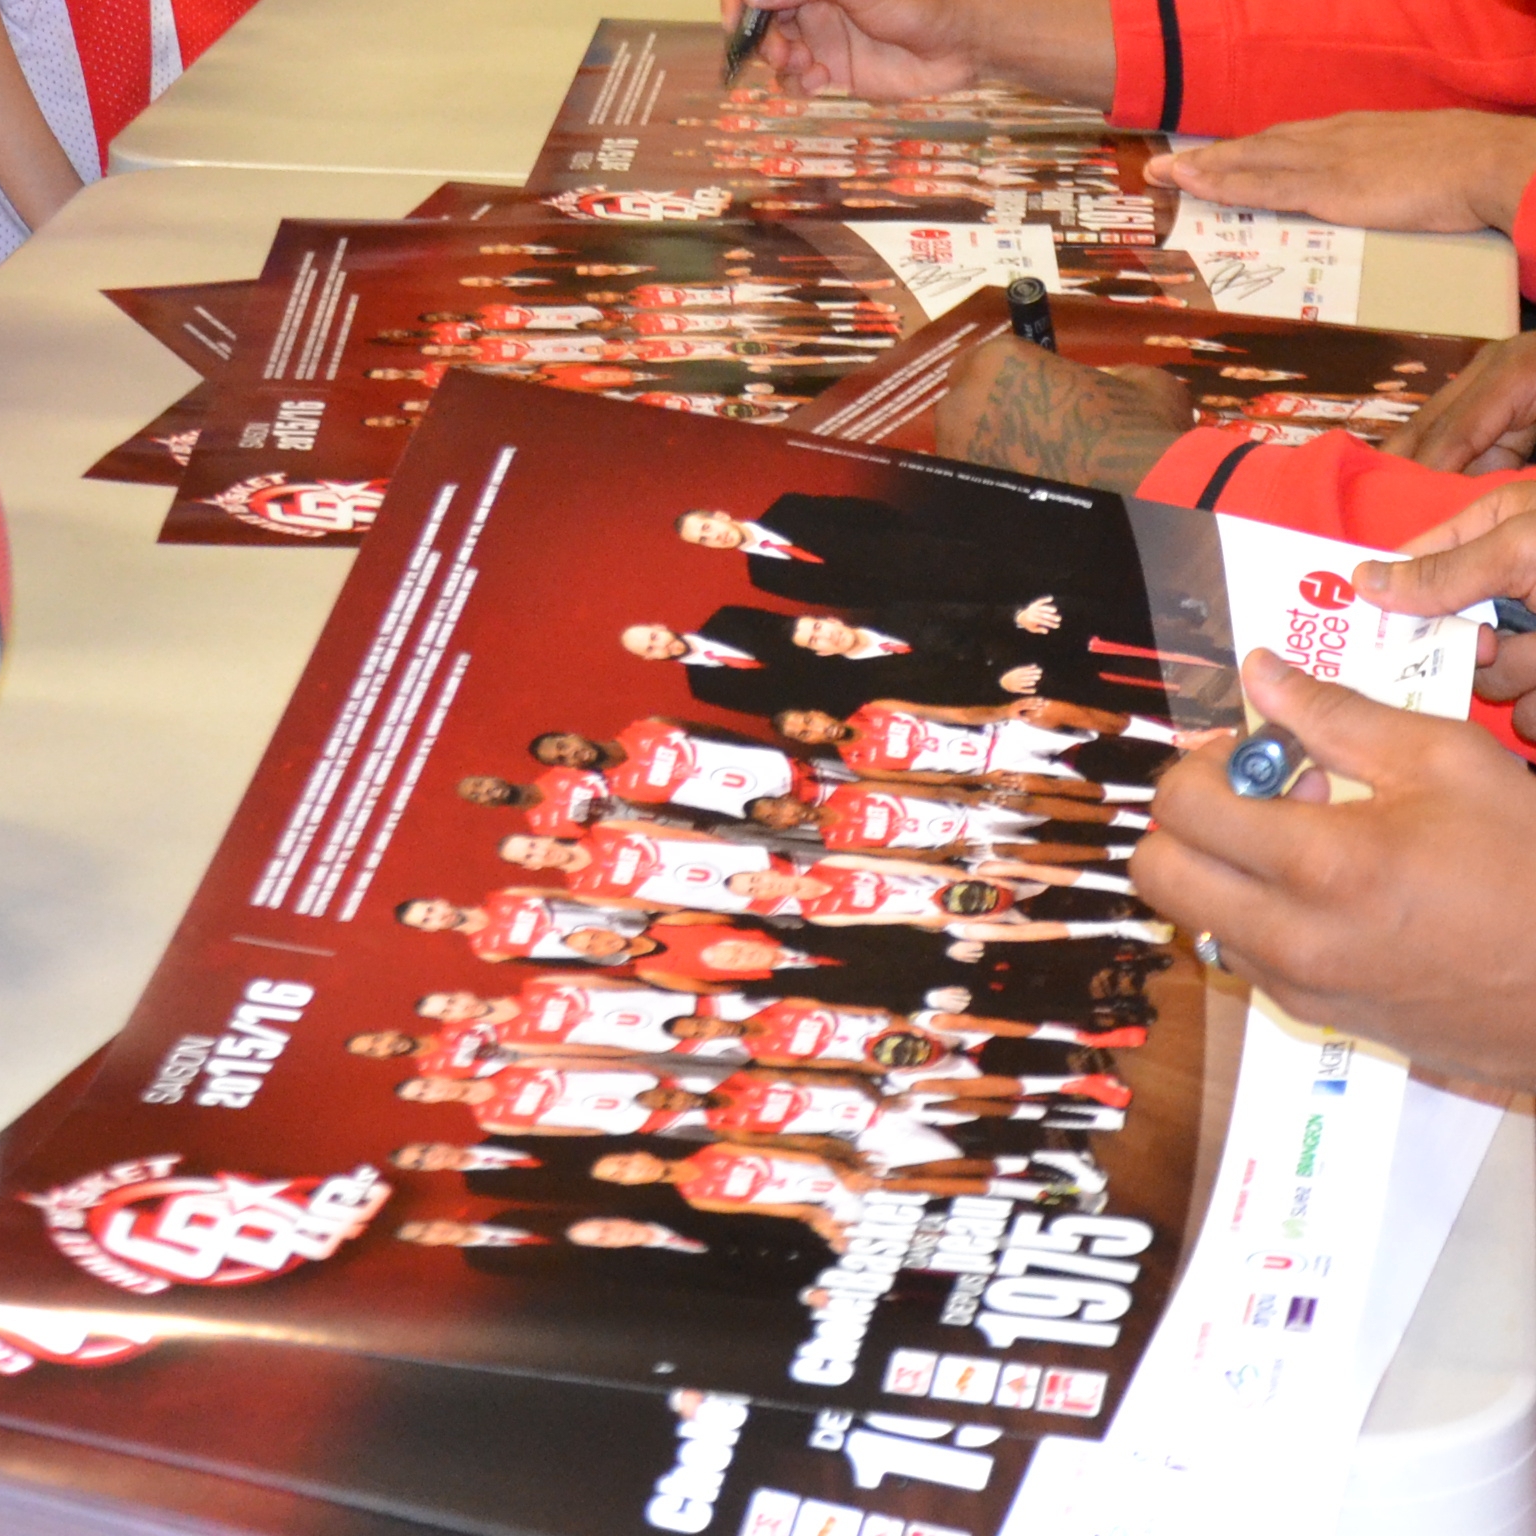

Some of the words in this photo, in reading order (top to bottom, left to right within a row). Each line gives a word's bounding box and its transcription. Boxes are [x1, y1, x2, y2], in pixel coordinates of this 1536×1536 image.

[1284, 607, 1321, 674] uest
[140, 1033, 216, 1106] SAISON
[197, 978, 316, 1110] 2015/16
[928, 1195, 1015, 1274] peau
[940, 1272, 990, 1328] DEPUIS
[975, 1211, 1156, 1350] 1975
